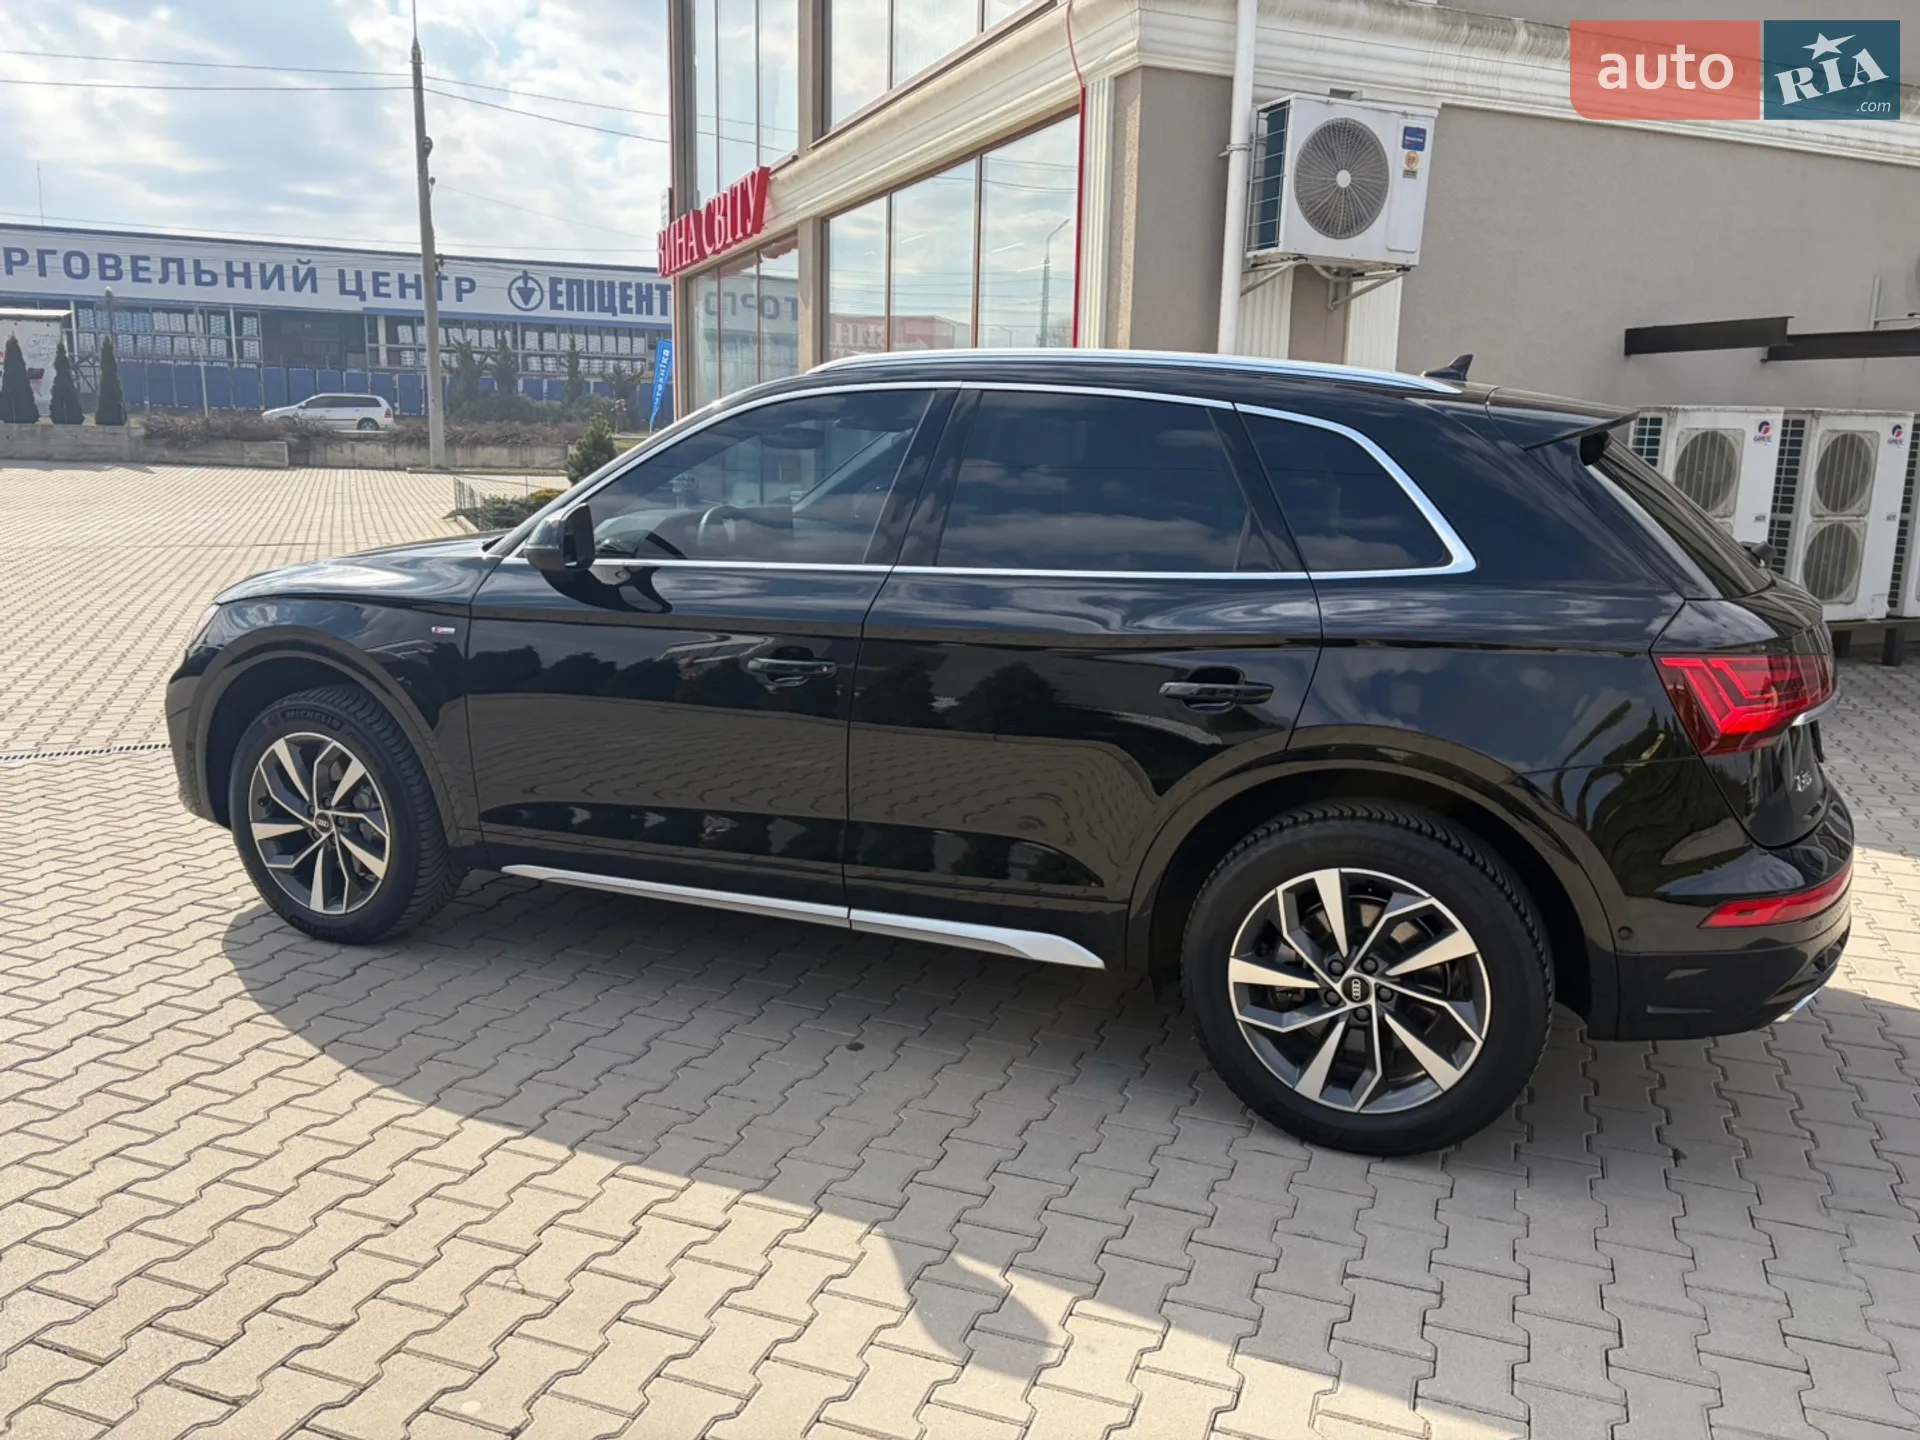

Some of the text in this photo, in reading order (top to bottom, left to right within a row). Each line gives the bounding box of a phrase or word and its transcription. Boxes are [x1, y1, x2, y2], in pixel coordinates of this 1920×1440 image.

[656, 167, 764, 276] ВИНА СВІТУ
[3, 246, 672, 316] РГОВЕЛЬНИЙ ЦЕНТР ЕПІЦЕНТ
[285, 709, 342, 729] MICHELIN
